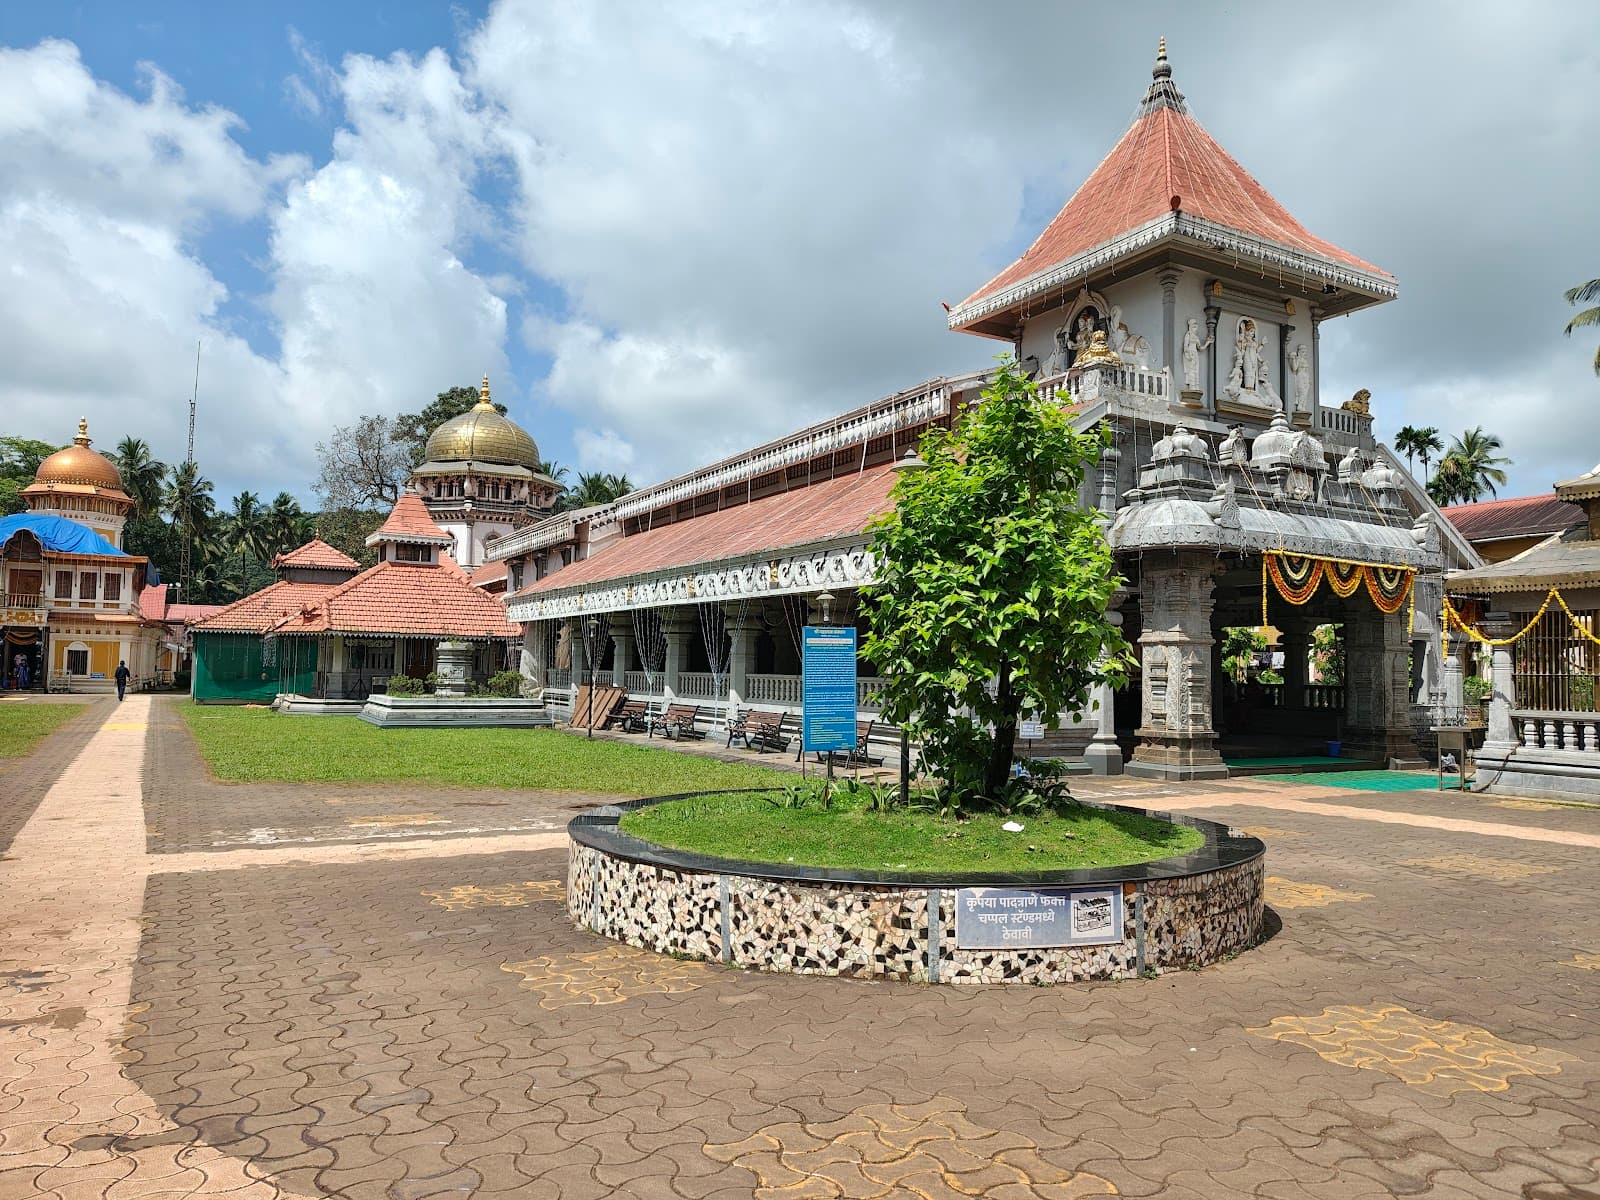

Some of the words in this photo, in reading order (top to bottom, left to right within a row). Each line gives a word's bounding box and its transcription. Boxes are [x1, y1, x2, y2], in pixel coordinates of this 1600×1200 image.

[966, 896, 997, 911] कृपया
[999, 894, 1038, 907] पादत्राणे
[978, 913, 1008, 923] चप्पल
[1002, 926, 1032, 940] ठेवावी
